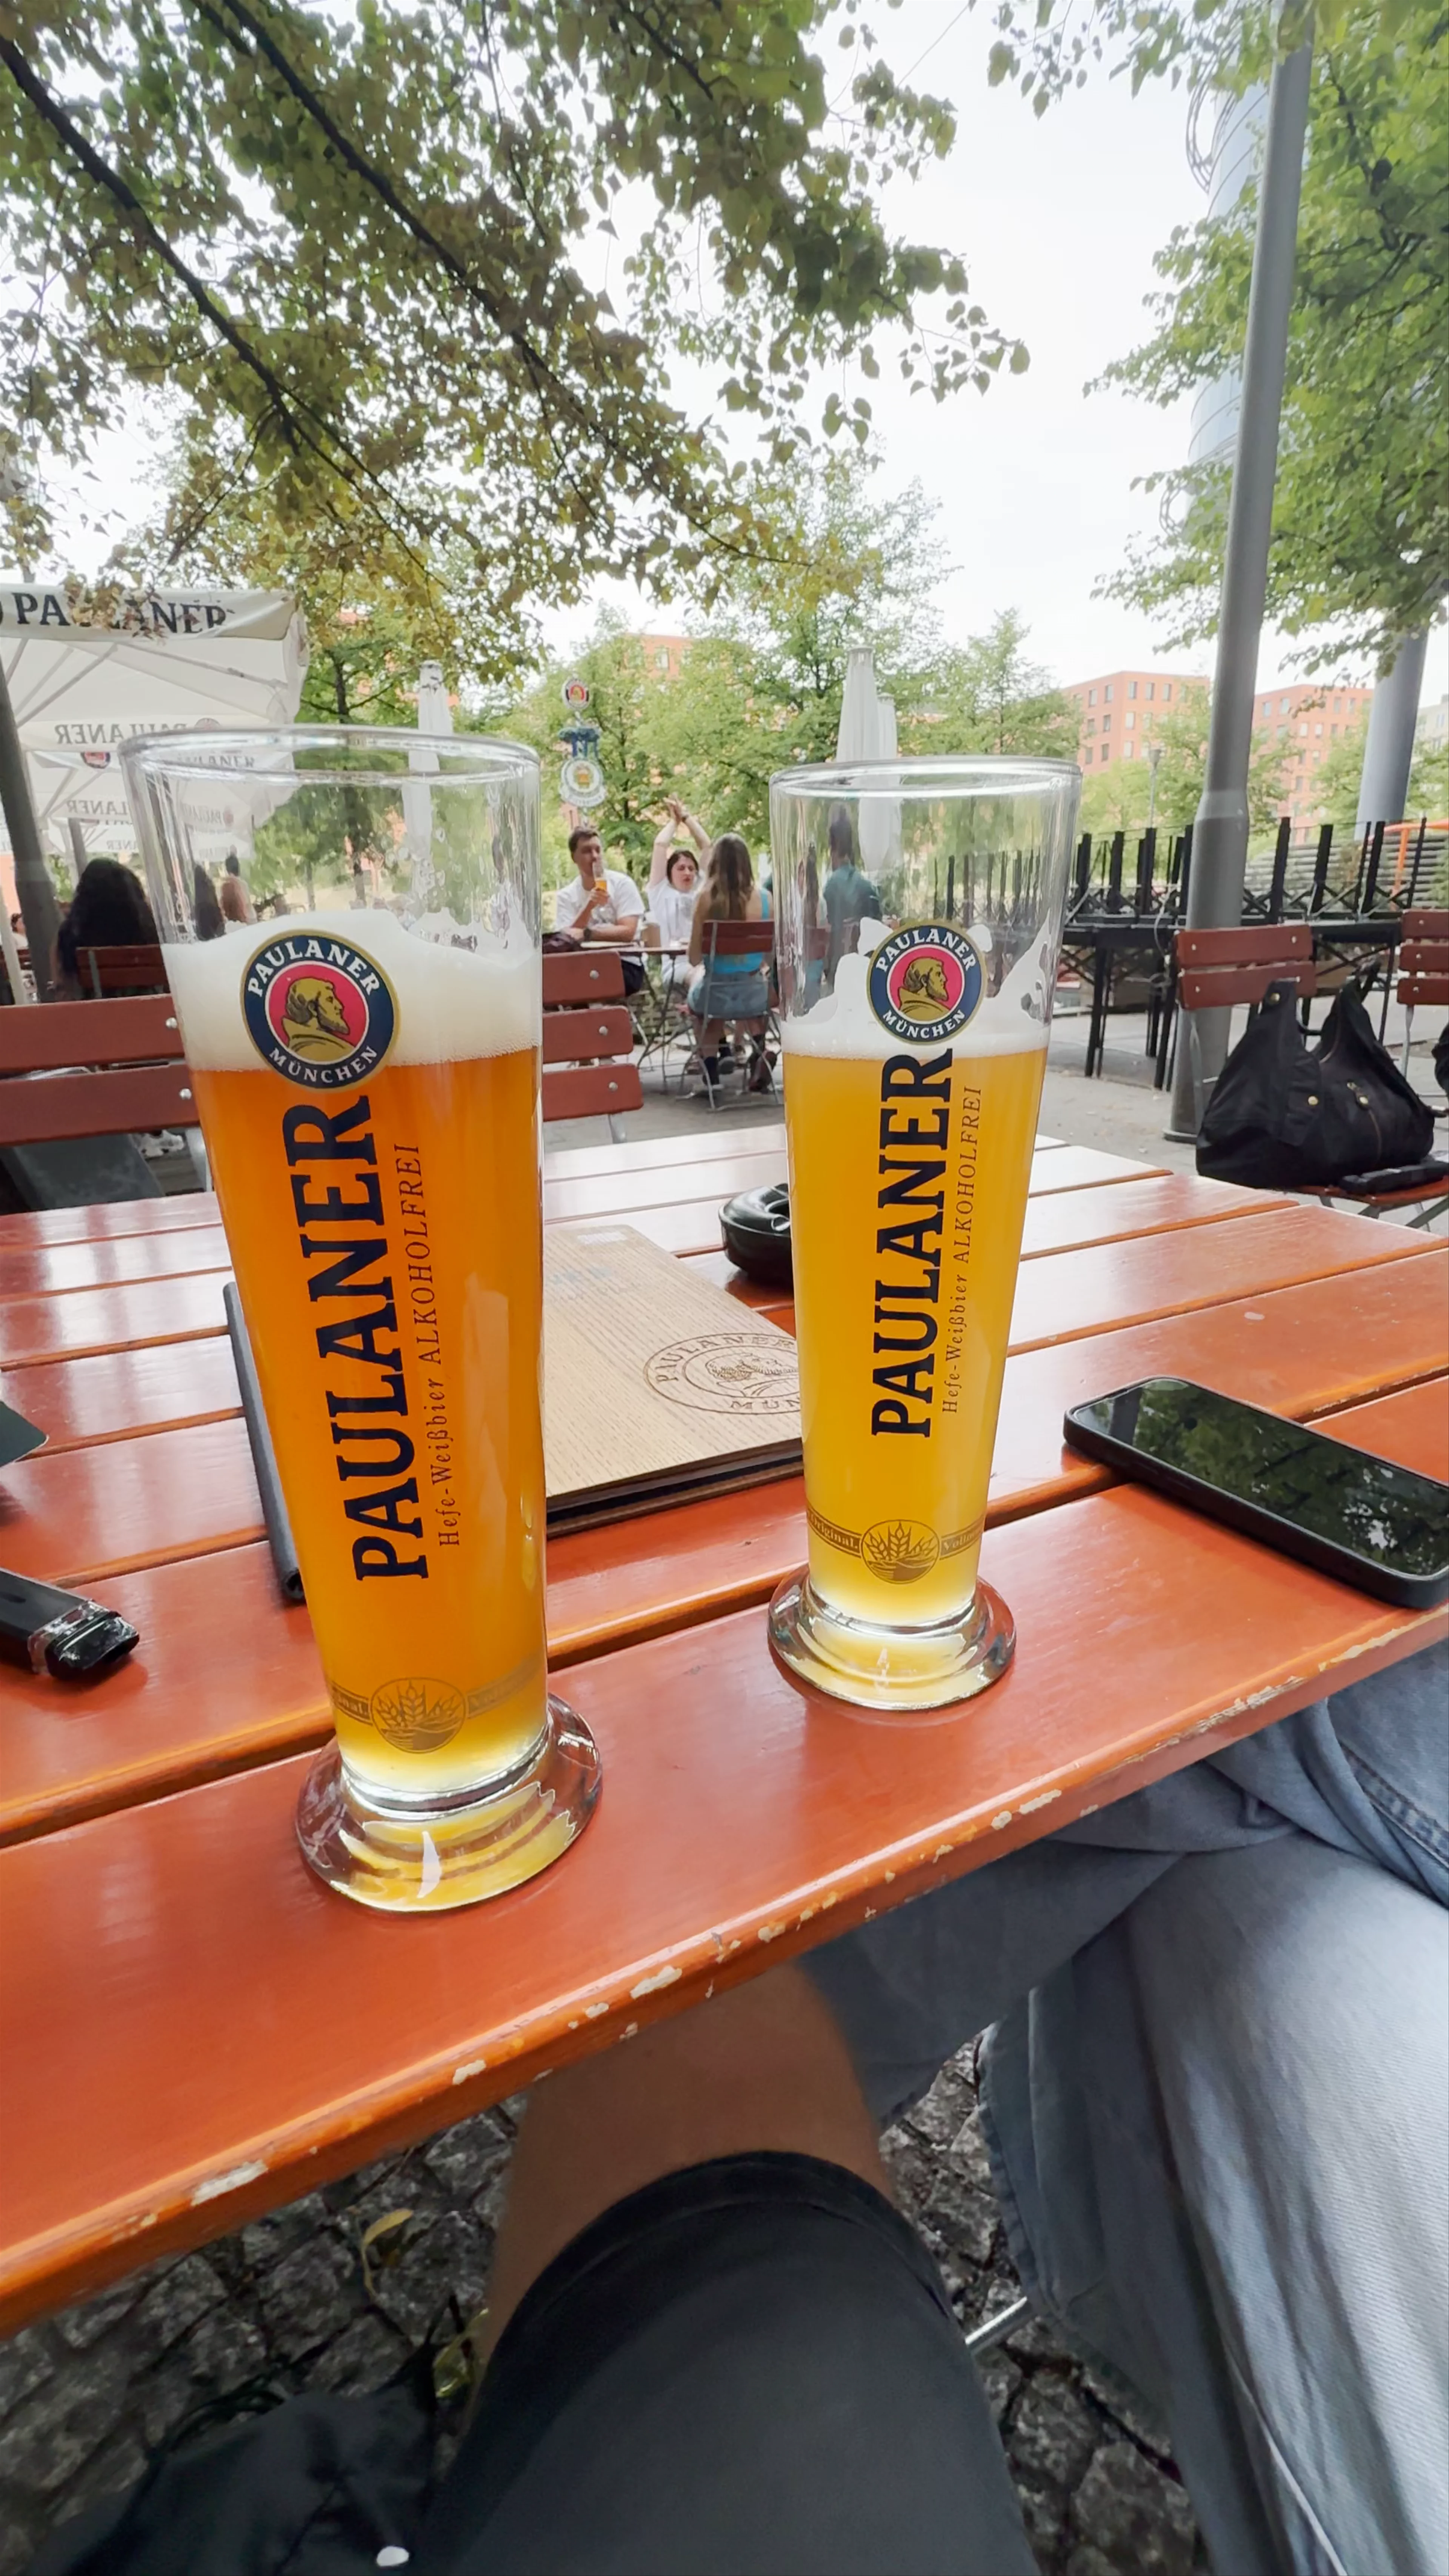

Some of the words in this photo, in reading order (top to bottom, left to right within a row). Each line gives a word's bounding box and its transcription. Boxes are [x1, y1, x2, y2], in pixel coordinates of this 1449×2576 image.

[12, 592, 226, 634] PANER
[248, 939, 380, 997] PAULANER
[876, 928, 977, 972] PAULANER
[269, 1046, 378, 1083] MÜNCHEN
[883, 1009, 966, 1038] MÜNCHEN
[953, 1086, 981, 1264] ALKOHOLFREI
[394, 1144, 441, 1365] ALKOHOLFREI
[871, 1048, 953, 1438] PAULANER
[282, 1095, 429, 1581] PAULANER
[655, 1336, 794, 1383] PAULANER
[942, 1274, 968, 1413] Hefe-Weißbier
[423, 1378, 461, 1546] Hefe-Weißbier
